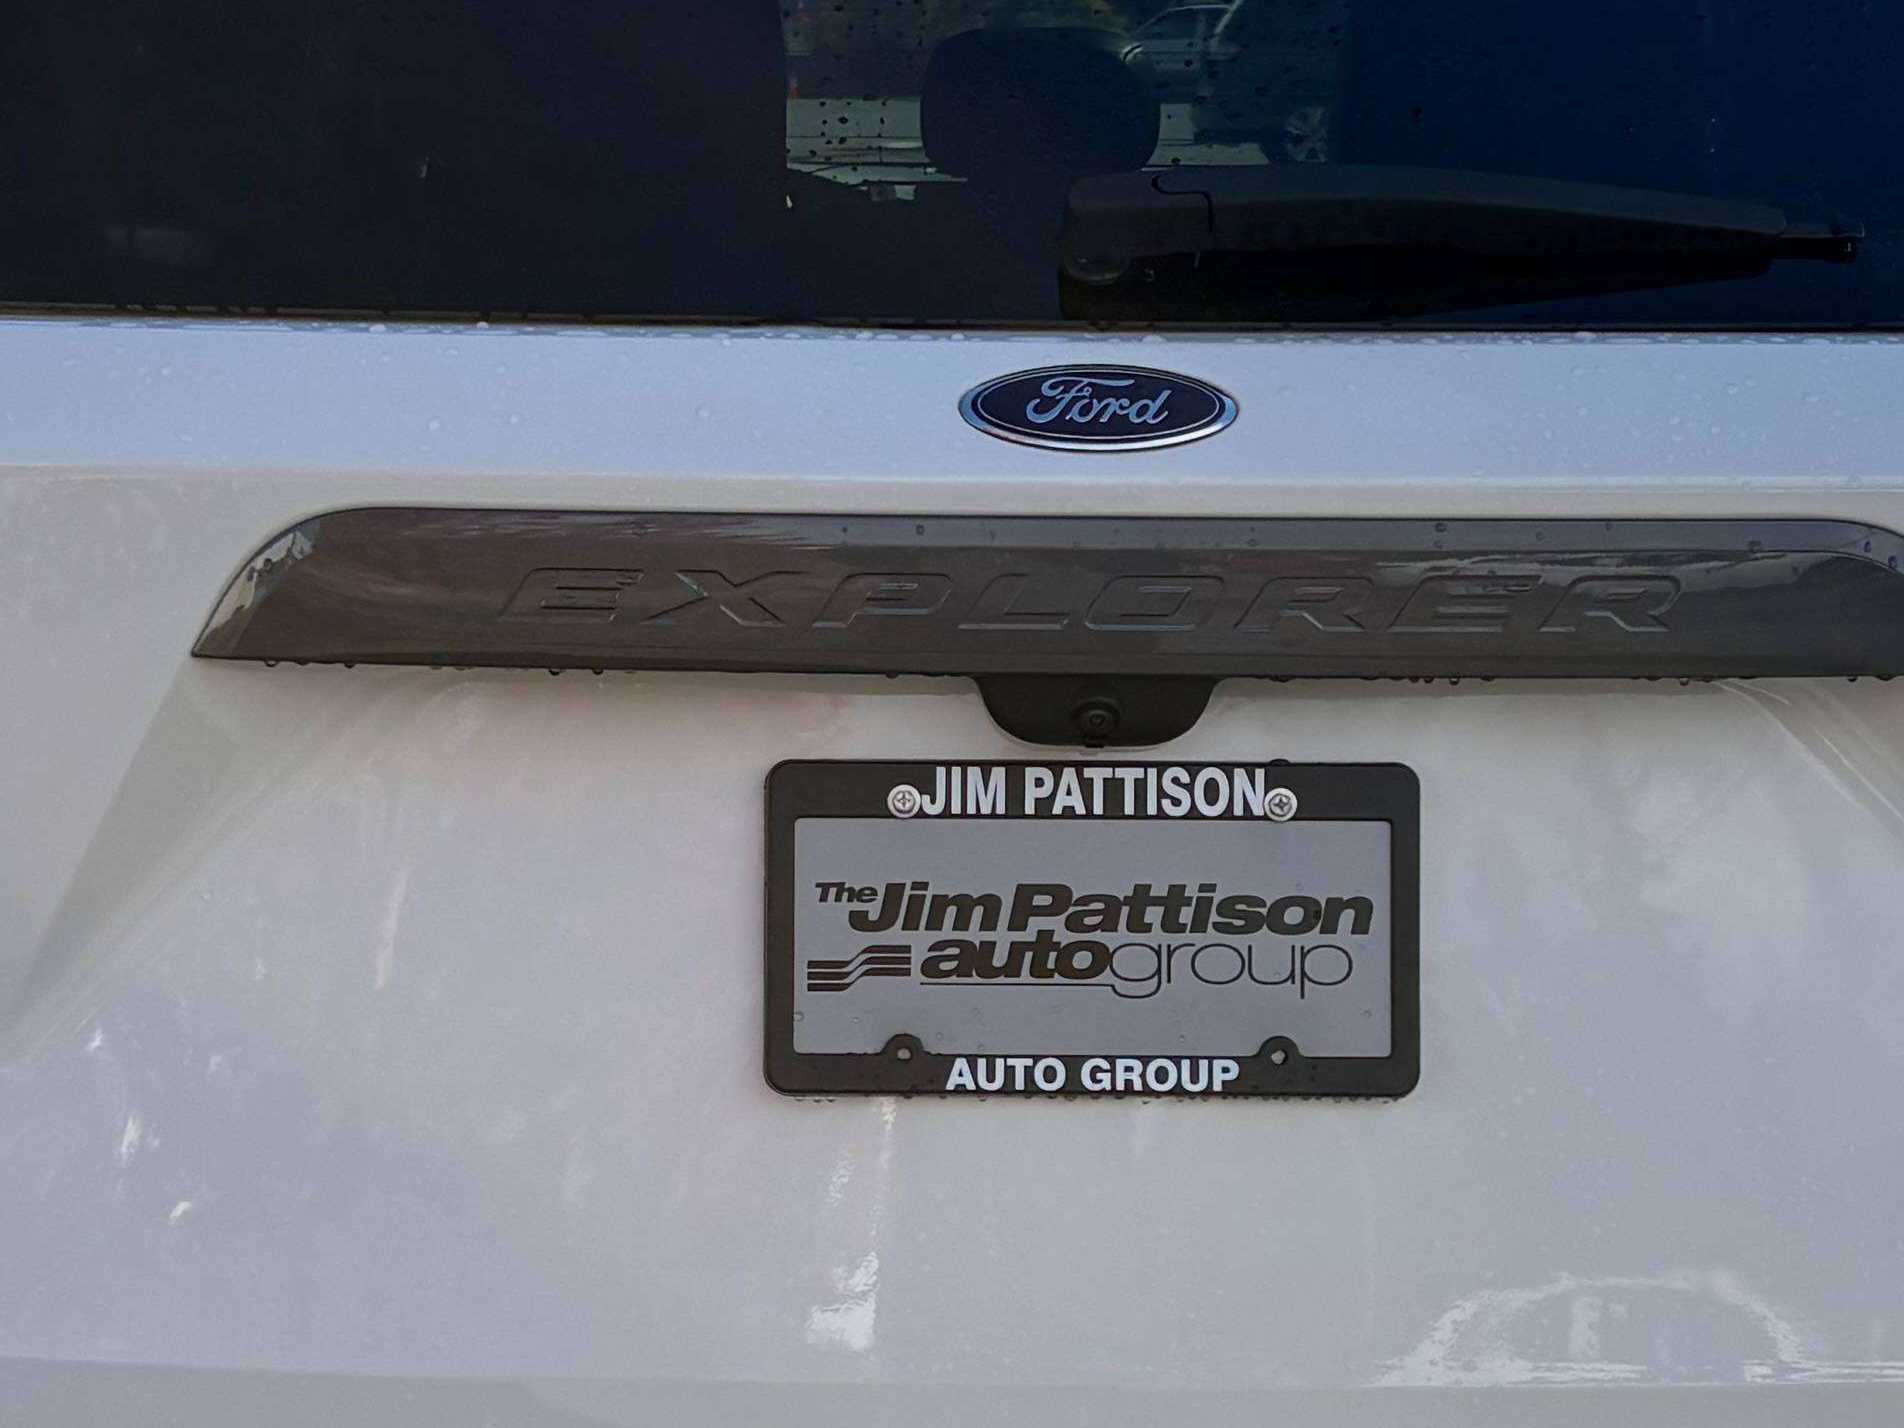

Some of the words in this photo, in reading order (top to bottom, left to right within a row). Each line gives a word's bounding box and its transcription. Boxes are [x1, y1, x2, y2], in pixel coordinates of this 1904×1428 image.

[1025, 376, 1172, 425] Ford
[498, 567, 1683, 633] EXPLORER
[920, 766, 1007, 816] JIM
[1024, 766, 1266, 818] PATTISON
[815, 882, 879, 904] The
[946, 1056, 1066, 1092] AUTO
[1080, 1057, 1240, 1093] GROUP
